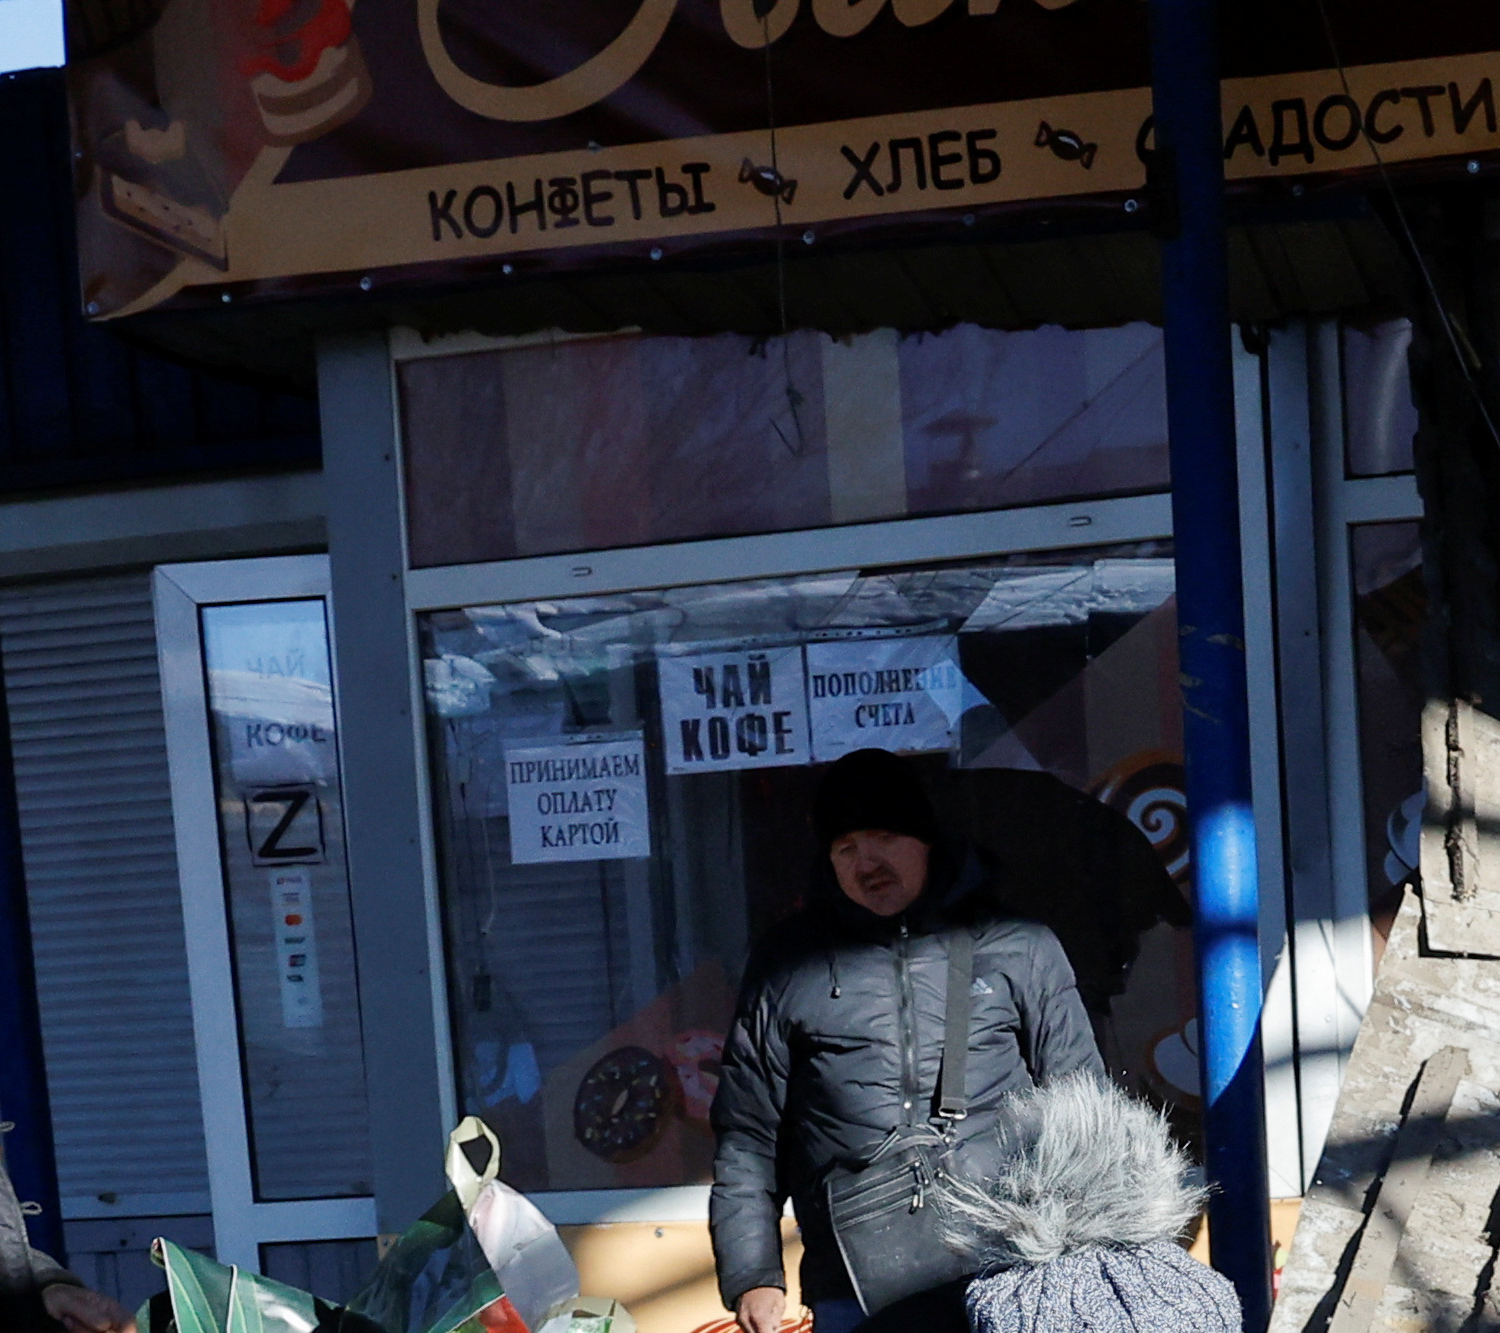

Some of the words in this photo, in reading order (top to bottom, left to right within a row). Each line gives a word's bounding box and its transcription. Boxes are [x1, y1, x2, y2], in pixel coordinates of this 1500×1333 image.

[428, 161, 715, 241] КОНФЕТЫ
[840, 129, 1002, 199] ХЛЕБ
[1136, 79, 1497, 167] САДОСТИ
[246, 650, 304, 680] ЧАЙ
[692, 654, 772, 709] ЧАЙ
[854, 701, 915, 730] СЧЕТА
[680, 710, 794, 762] КОФЕ
[510, 754, 641, 786] ПРИНИМАЕМ
[537, 788, 618, 816] ОПЛАТУ
[253, 791, 317, 858] Z
[540, 816, 620, 848] КАРТОЙ
